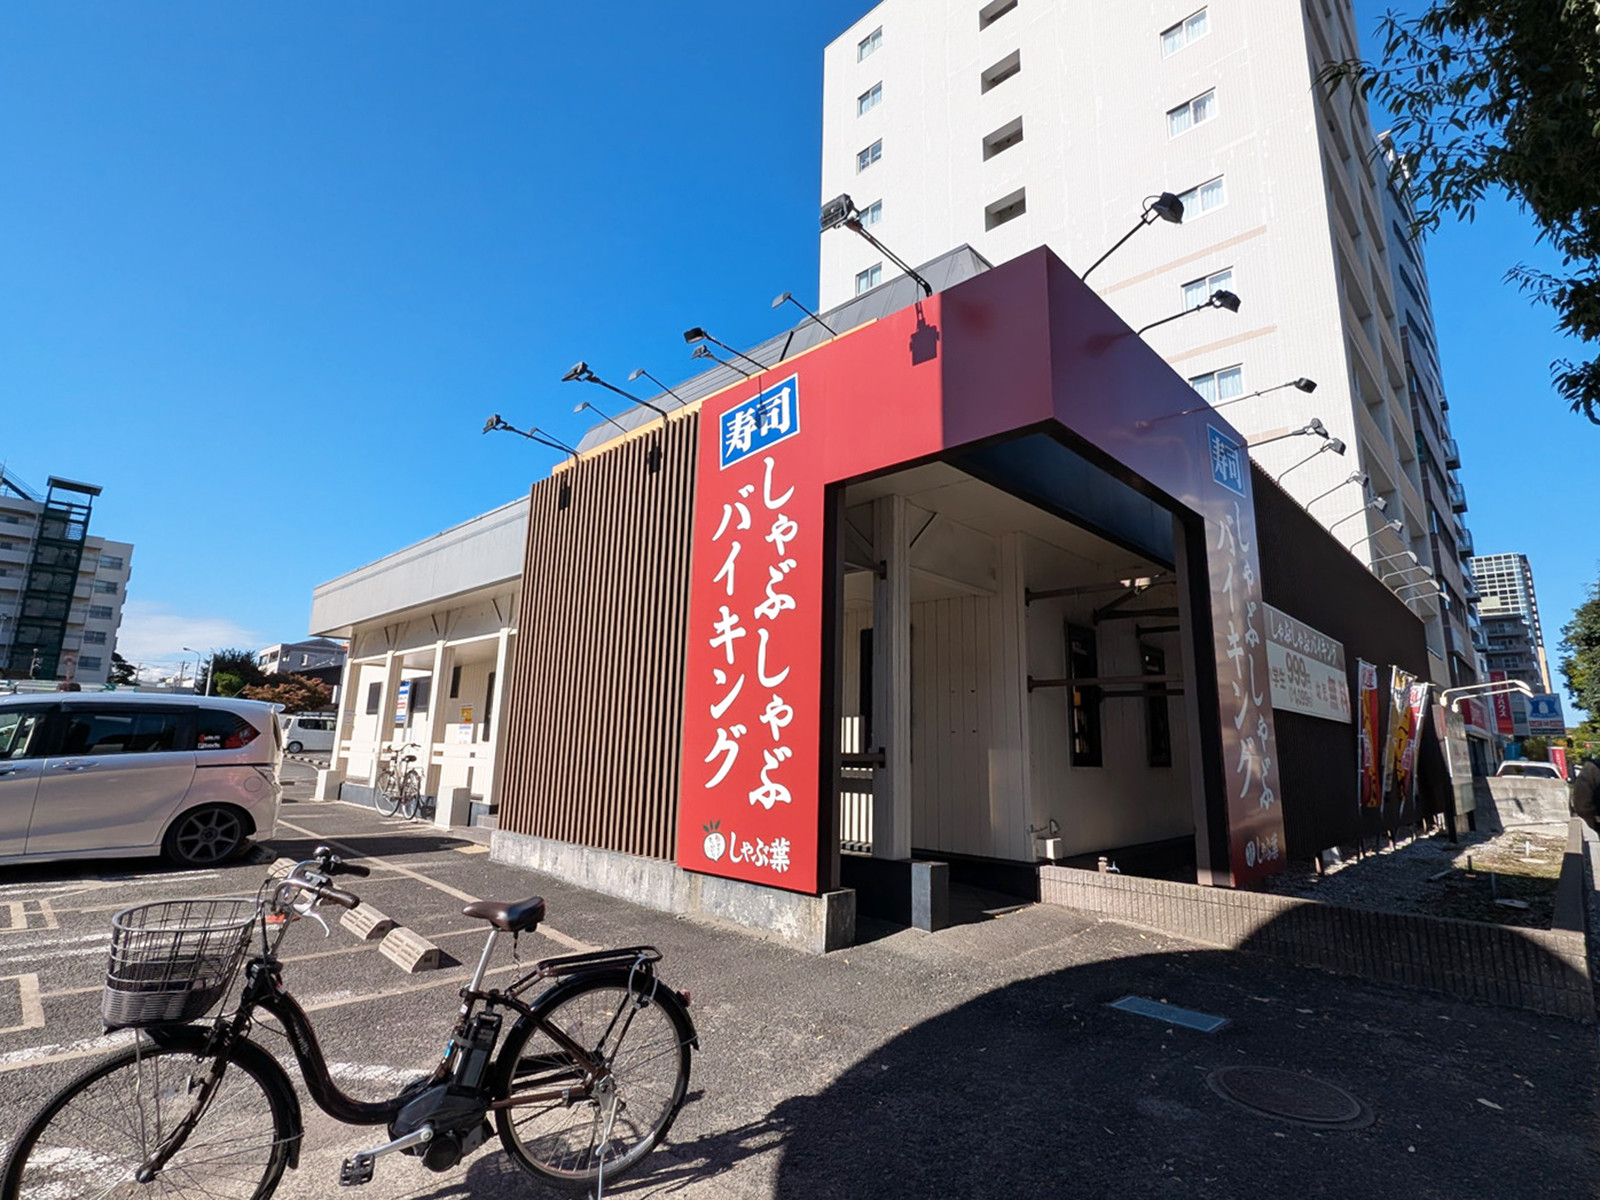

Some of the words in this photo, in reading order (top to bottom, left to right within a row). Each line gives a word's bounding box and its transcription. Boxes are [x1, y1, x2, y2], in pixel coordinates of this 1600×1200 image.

[725, 386, 792, 459] 寿司
[1211, 436, 1243, 490] 寿司
[703, 483, 755, 789] バイキング
[748, 456, 799, 811] しゃぶしゃぶ
[1216, 514, 1256, 799] バイキング
[1233, 500, 1275, 811] しゃぶしゃぶ
[1270, 665, 1287, 690] 学生
[729, 831, 791, 874] しゃぶ葉
